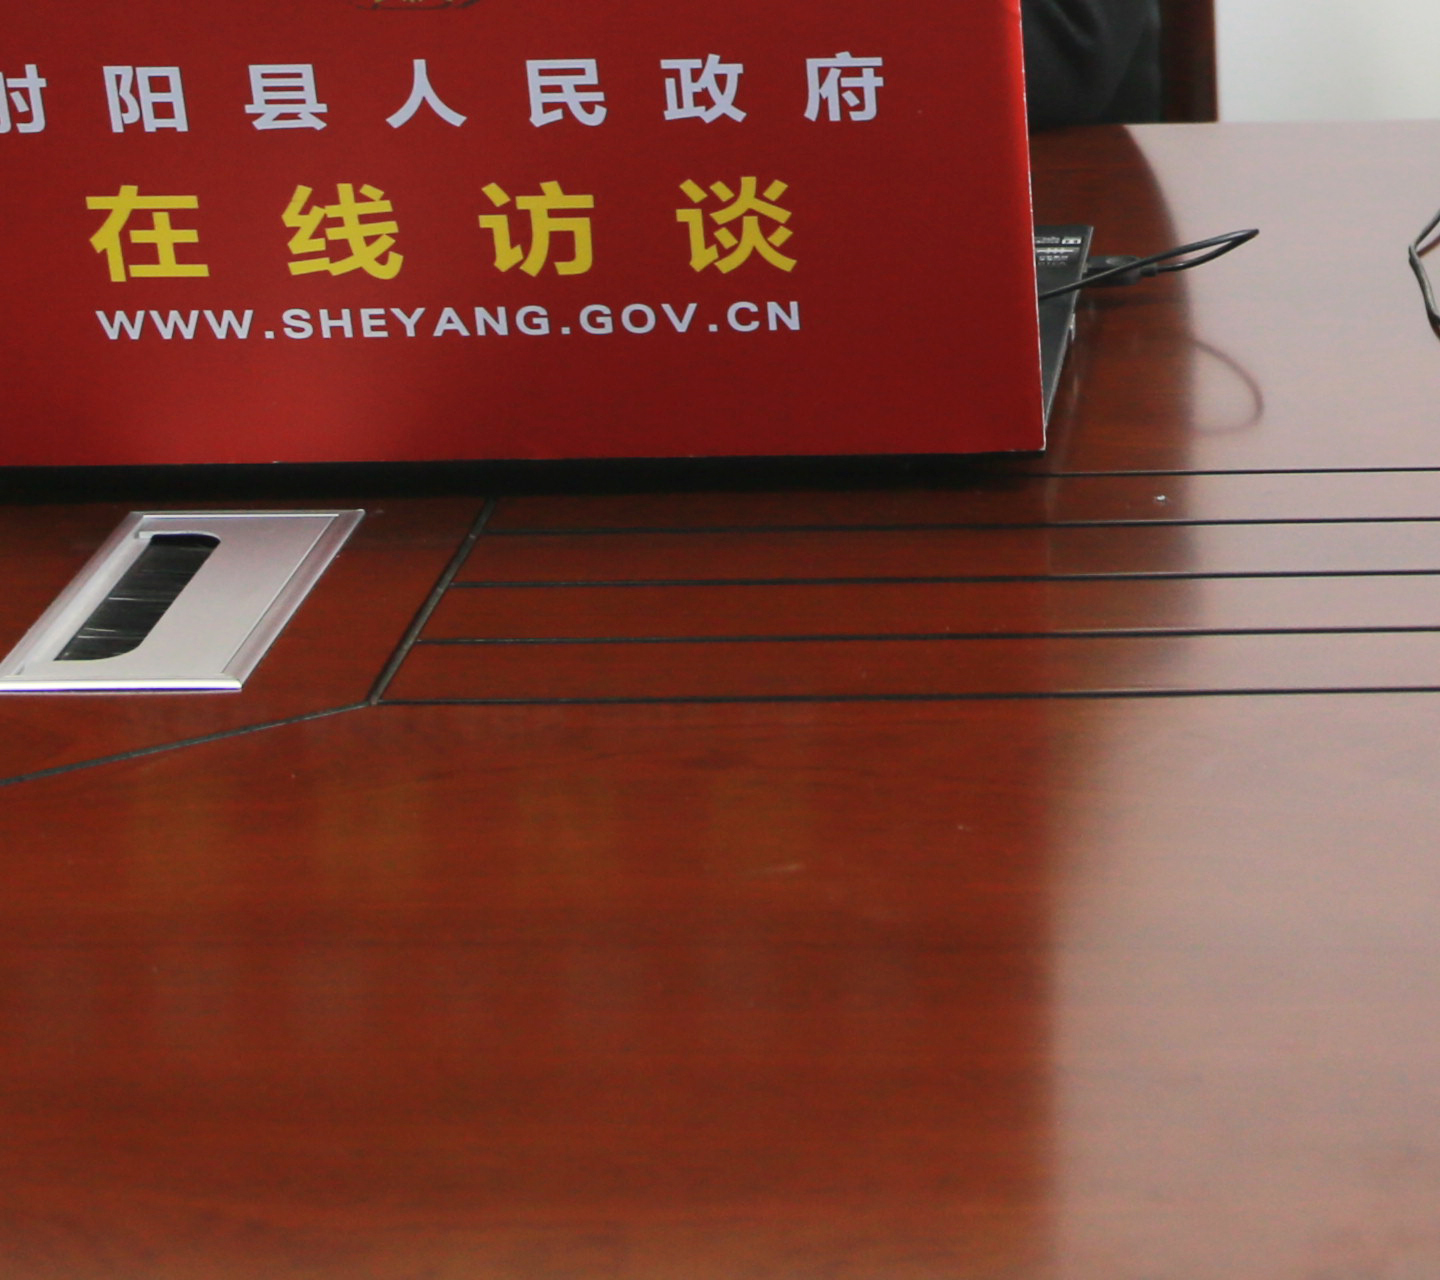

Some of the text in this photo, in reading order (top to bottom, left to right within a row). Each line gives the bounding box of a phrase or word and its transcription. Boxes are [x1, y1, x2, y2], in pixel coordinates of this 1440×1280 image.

[84, 175, 798, 284] 在线访谈
[95, 300, 801, 342] WWW.SHEYANG.GOV.CN
